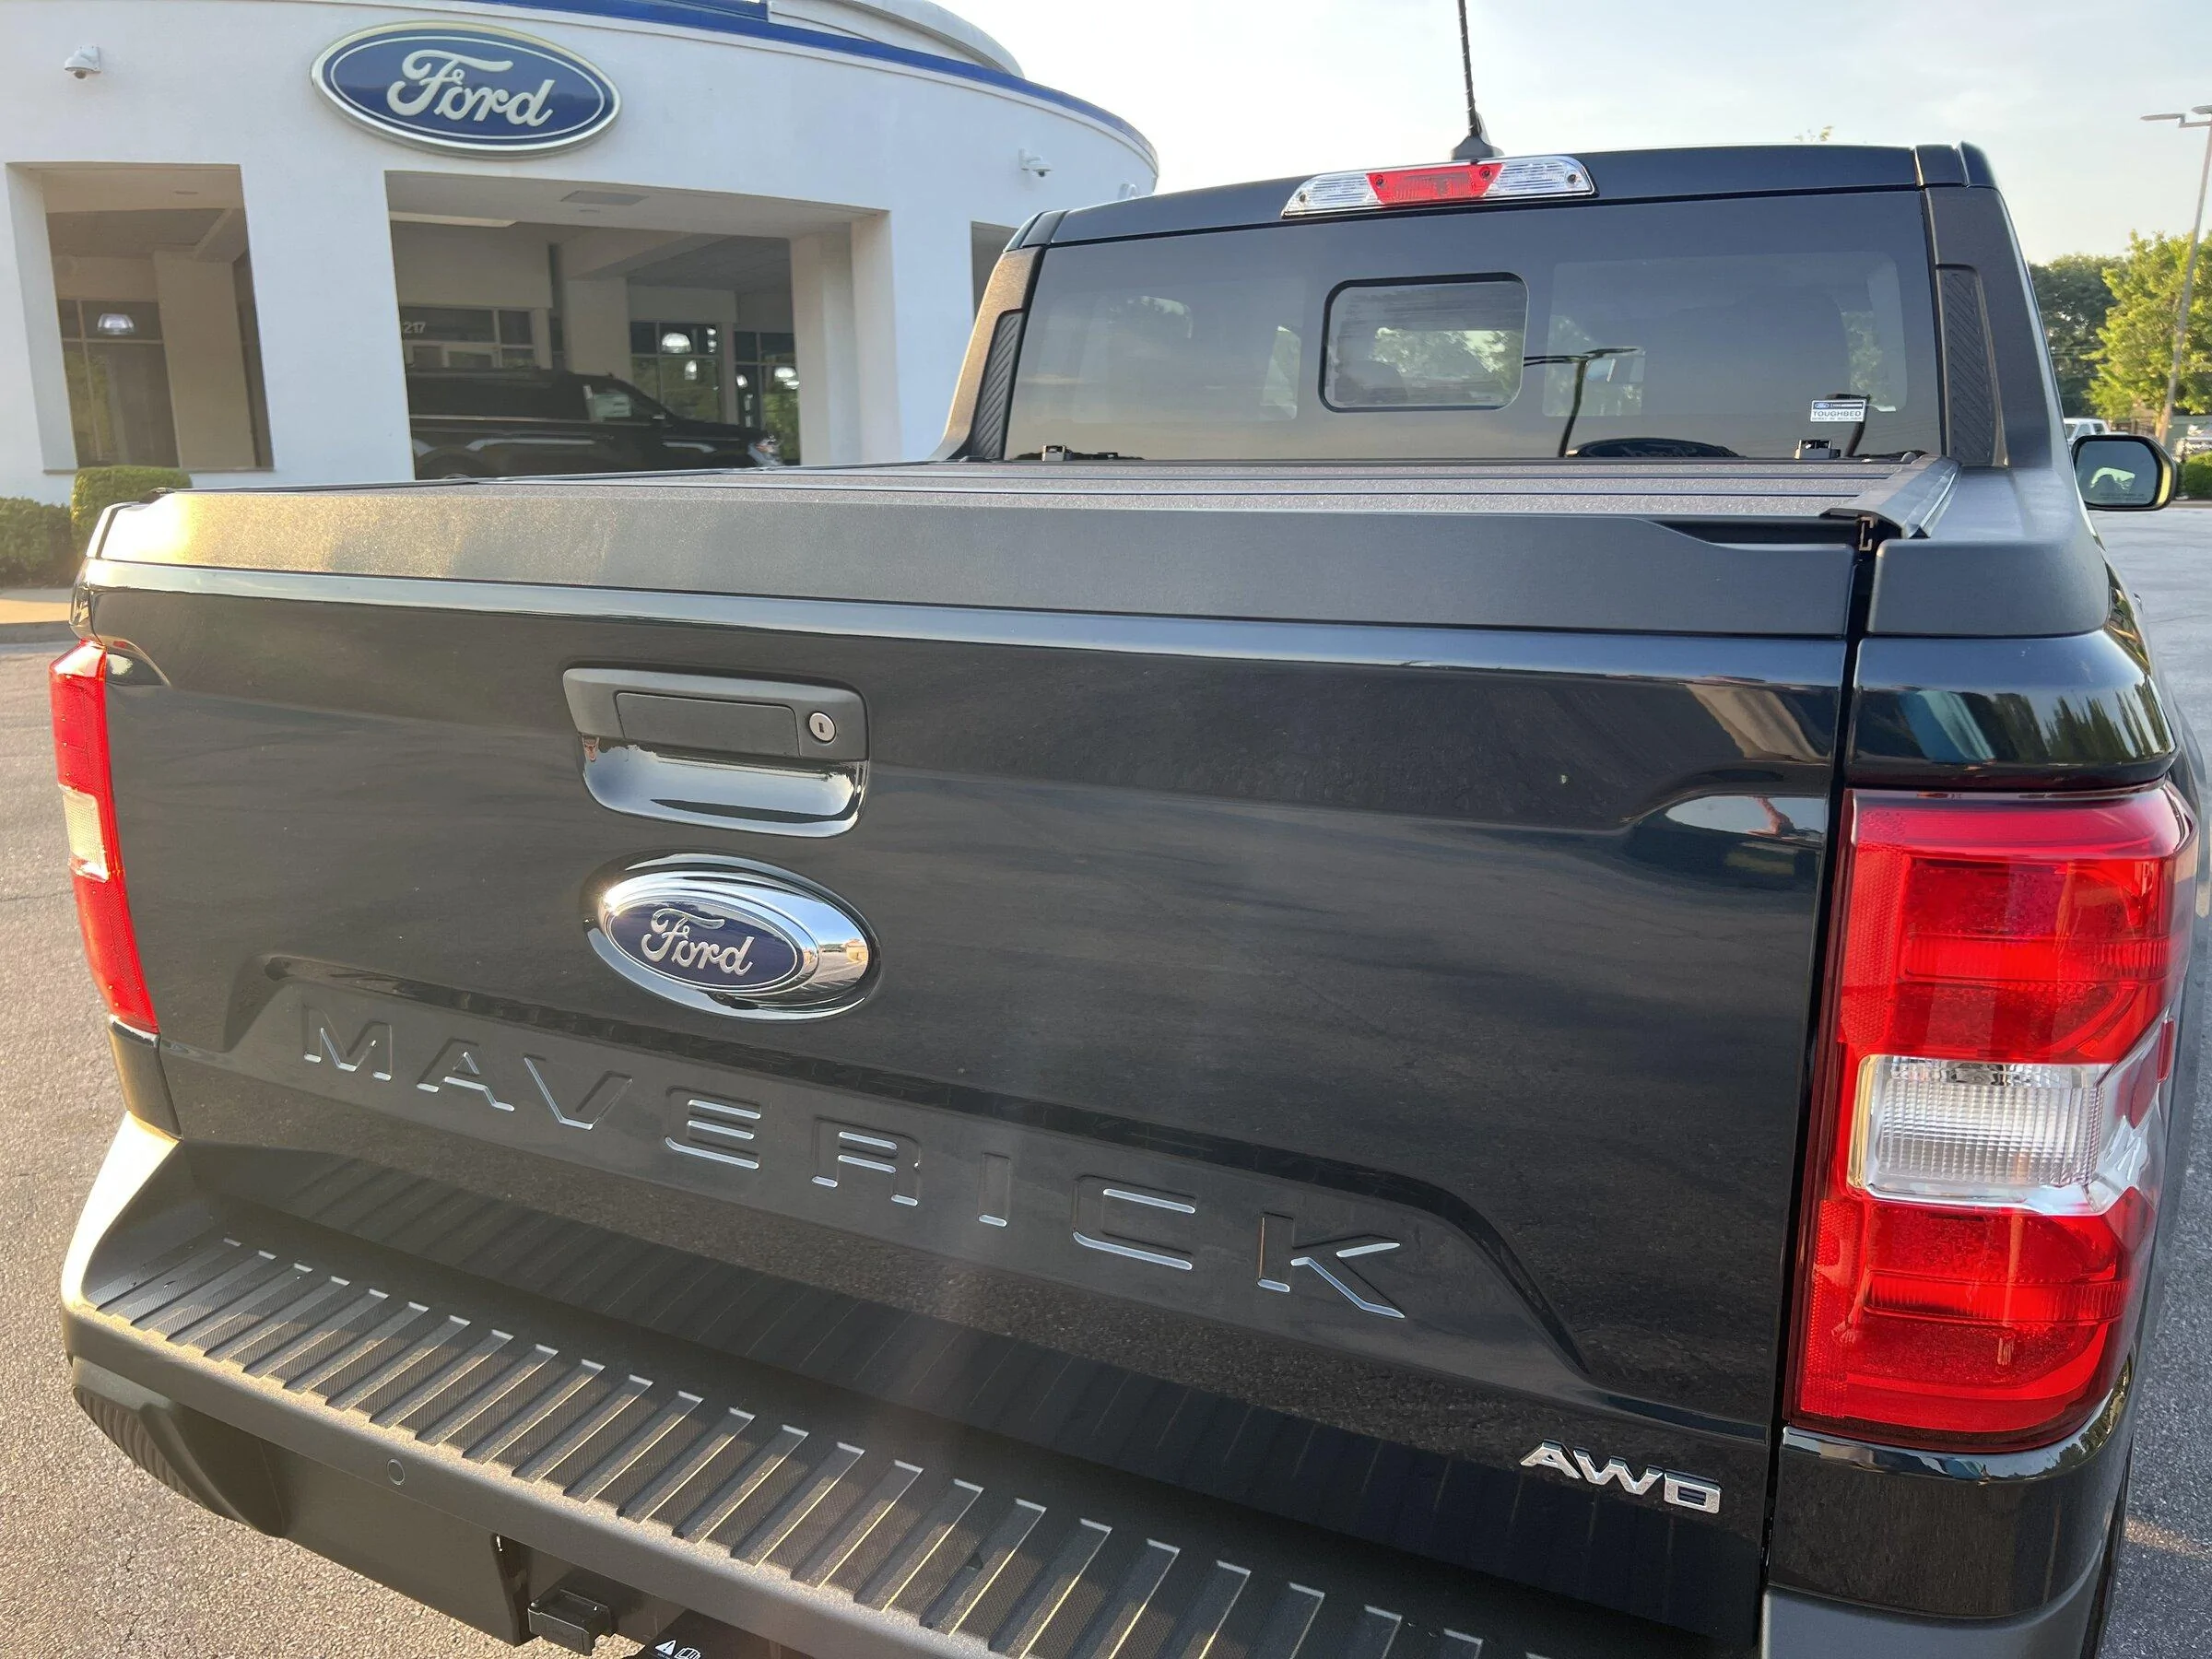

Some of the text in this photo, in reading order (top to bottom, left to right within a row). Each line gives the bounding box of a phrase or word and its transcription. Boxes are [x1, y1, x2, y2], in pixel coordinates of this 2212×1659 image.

[387, 49, 556, 127] Ford
[641, 908, 755, 976] Ford
[302, 1004, 1406, 1320] MAVERICK
[1520, 1439, 1723, 1514] AWD
